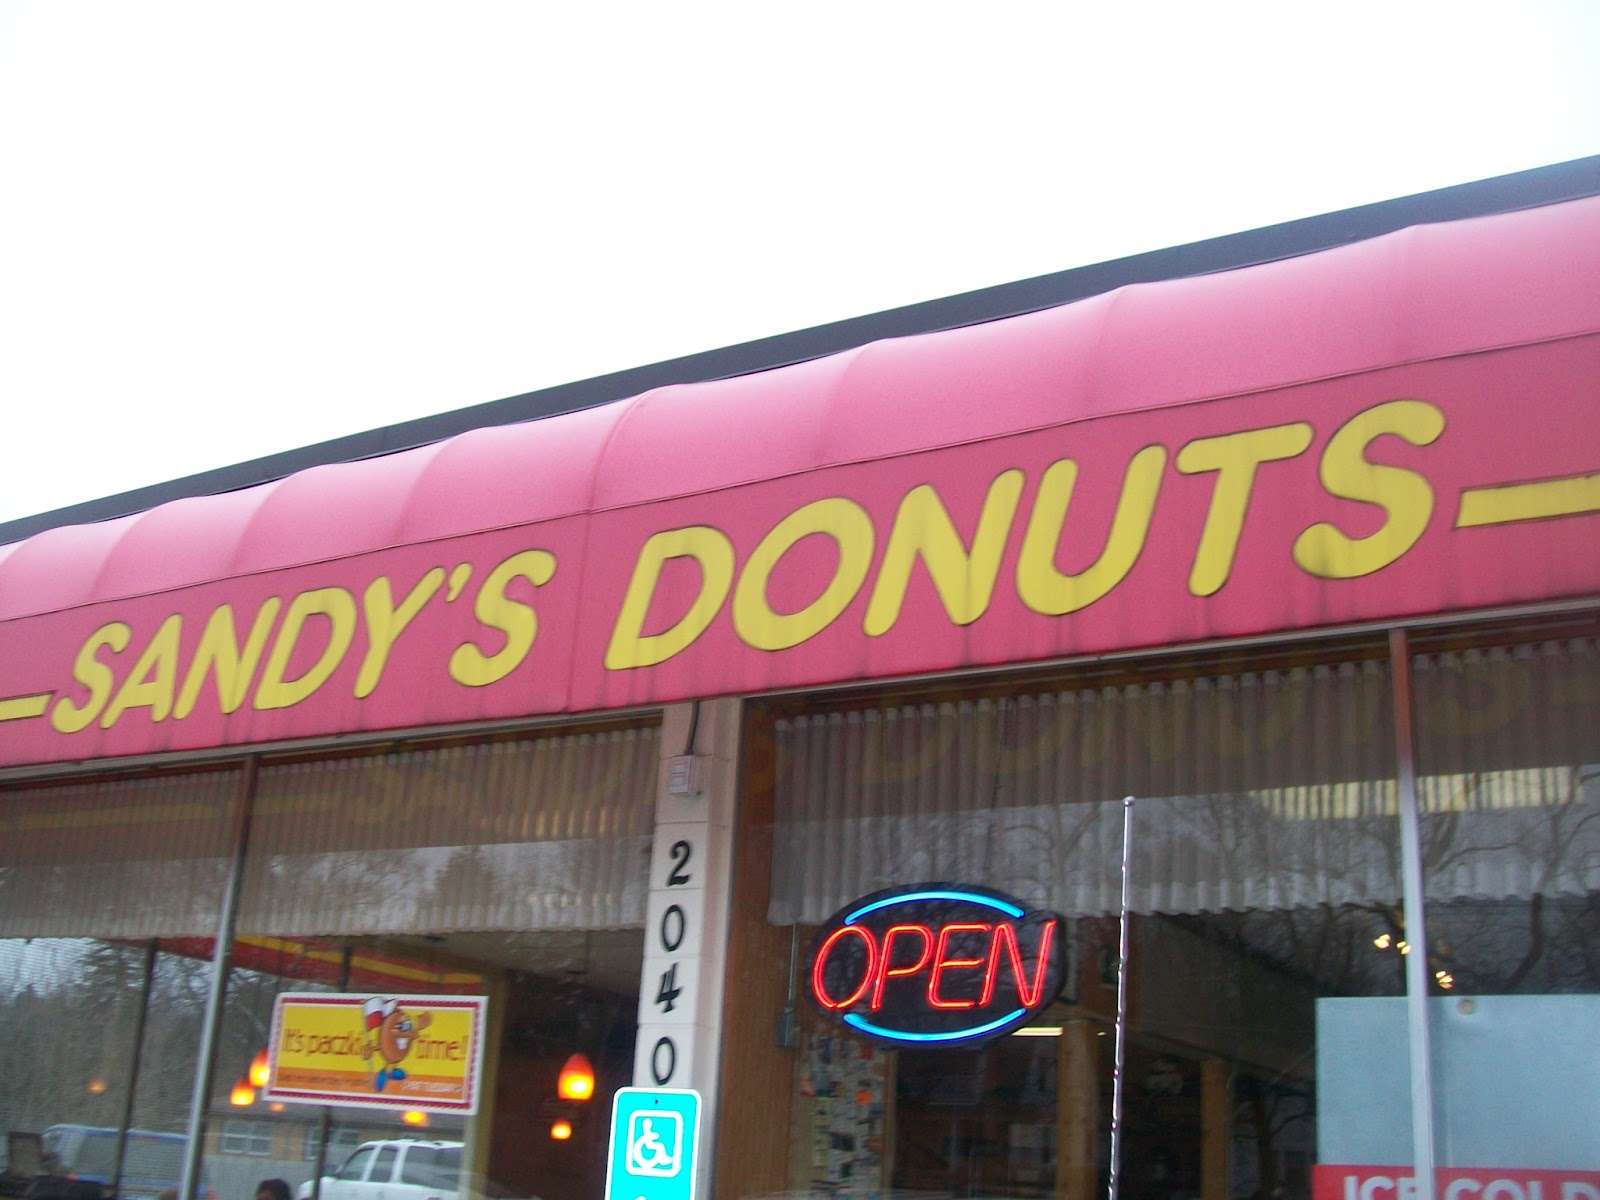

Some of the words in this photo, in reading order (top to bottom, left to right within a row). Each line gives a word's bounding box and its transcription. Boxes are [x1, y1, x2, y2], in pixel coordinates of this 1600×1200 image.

[50, 548, 558, 734] SANDY'S
[604, 399, 1446, 671] DONUTS
[812, 919, 1057, 1010] OPEN
